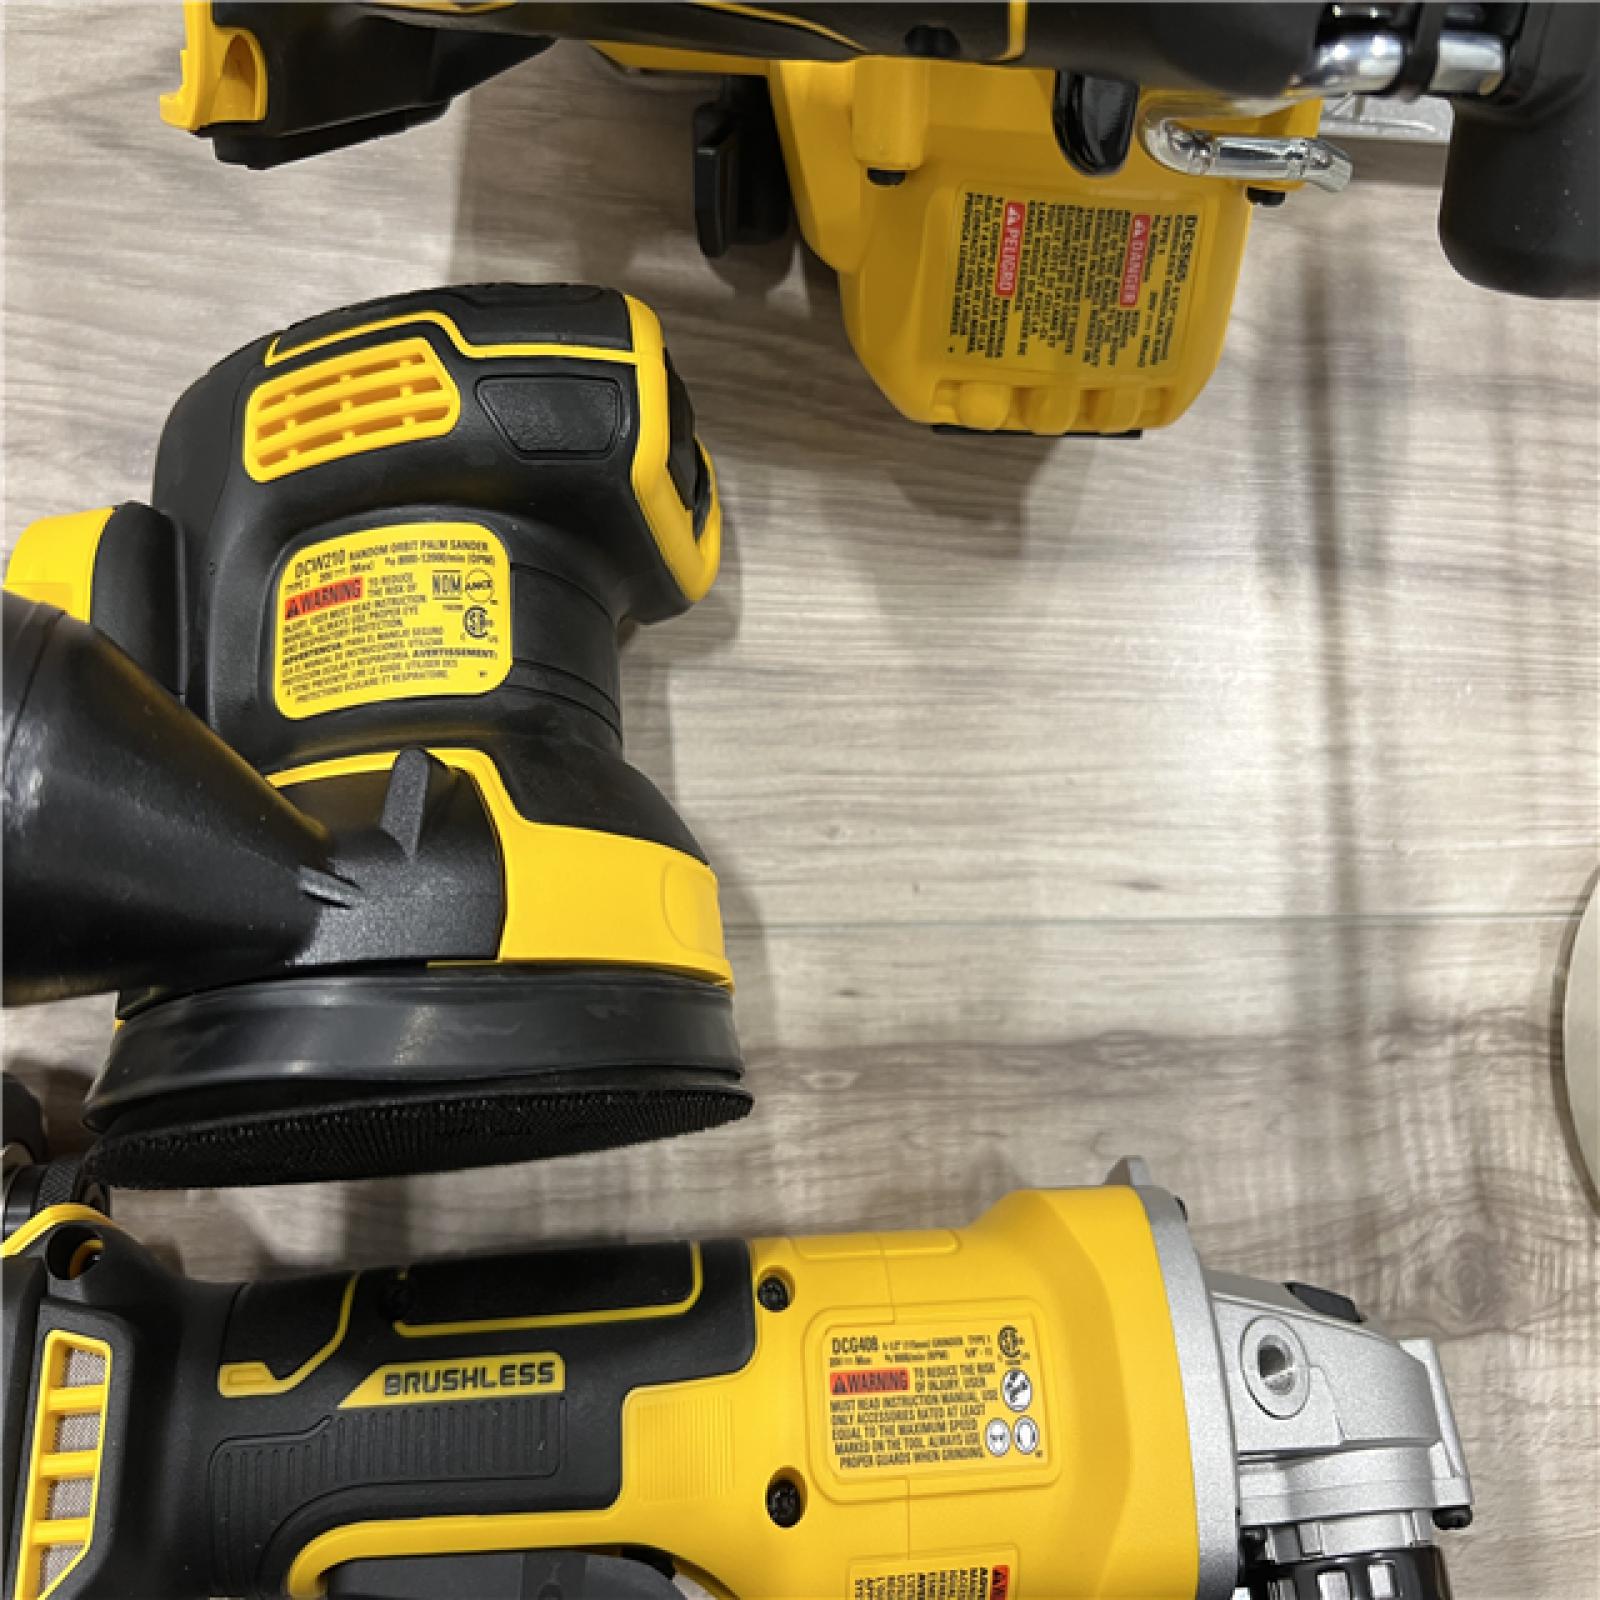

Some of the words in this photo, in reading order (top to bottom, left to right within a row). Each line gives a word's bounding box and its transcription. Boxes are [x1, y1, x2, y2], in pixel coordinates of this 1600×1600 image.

[997, 227, 1021, 292] PELIGRO
[1120, 239, 1145, 304] DANGER
[295, 549, 346, 579] DCW210
[301, 578, 362, 613] WARNING
[433, 573, 462, 597] NOM
[832, 1335, 879, 1356] DCG408
[384, 1360, 555, 1397] BRUSHLESS
[926, 1363, 959, 1378] REDUCE
[959, 1362, 976, 1376] THE
[976, 1361, 997, 1374] RISK
[848, 1370, 909, 1393] WARNING
[881, 1394, 939, 1409] INSTRUCTION
[856, 1408, 916, 1424] ACCESSORIES
[897, 1419, 946, 1436] MAXIMUM
[839, 1452, 873, 1470] PROPER
